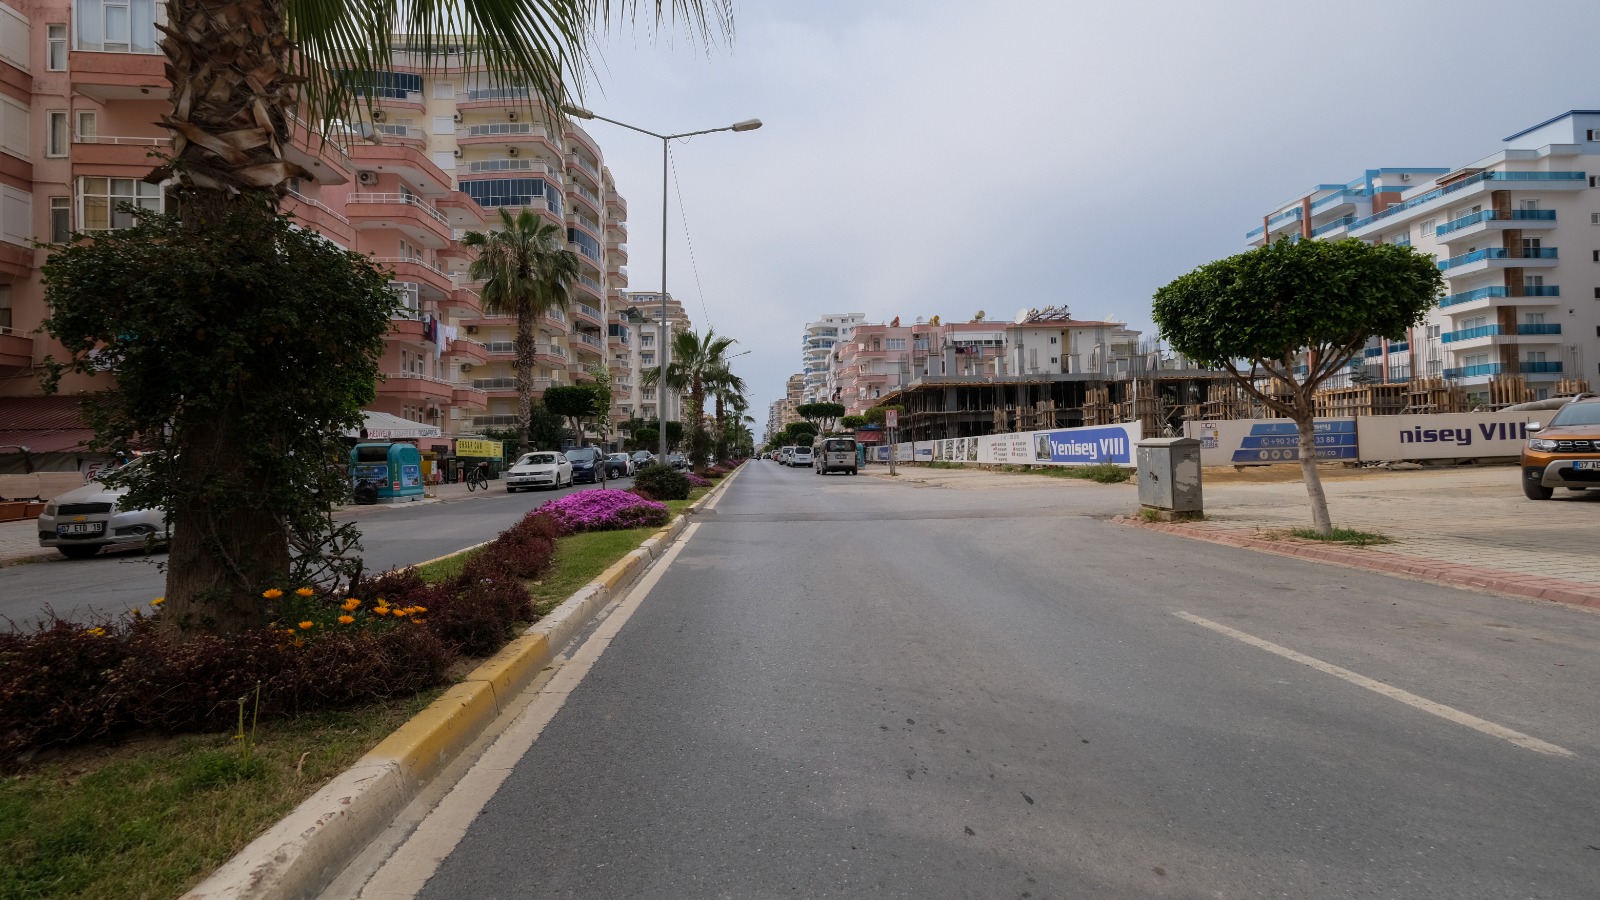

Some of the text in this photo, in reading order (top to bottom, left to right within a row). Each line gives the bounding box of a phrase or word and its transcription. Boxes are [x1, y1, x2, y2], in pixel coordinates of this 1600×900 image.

[1271, 437, 1285, 445] +90
[1315, 436, 1325, 444] 33
[1400, 425, 1472, 446] nisey
[1050, 439, 1098, 460] Yenisey
[1099, 437, 1125, 456] VIII
[61, 525, 70, 533] 07
[93, 523, 101, 531] 19
